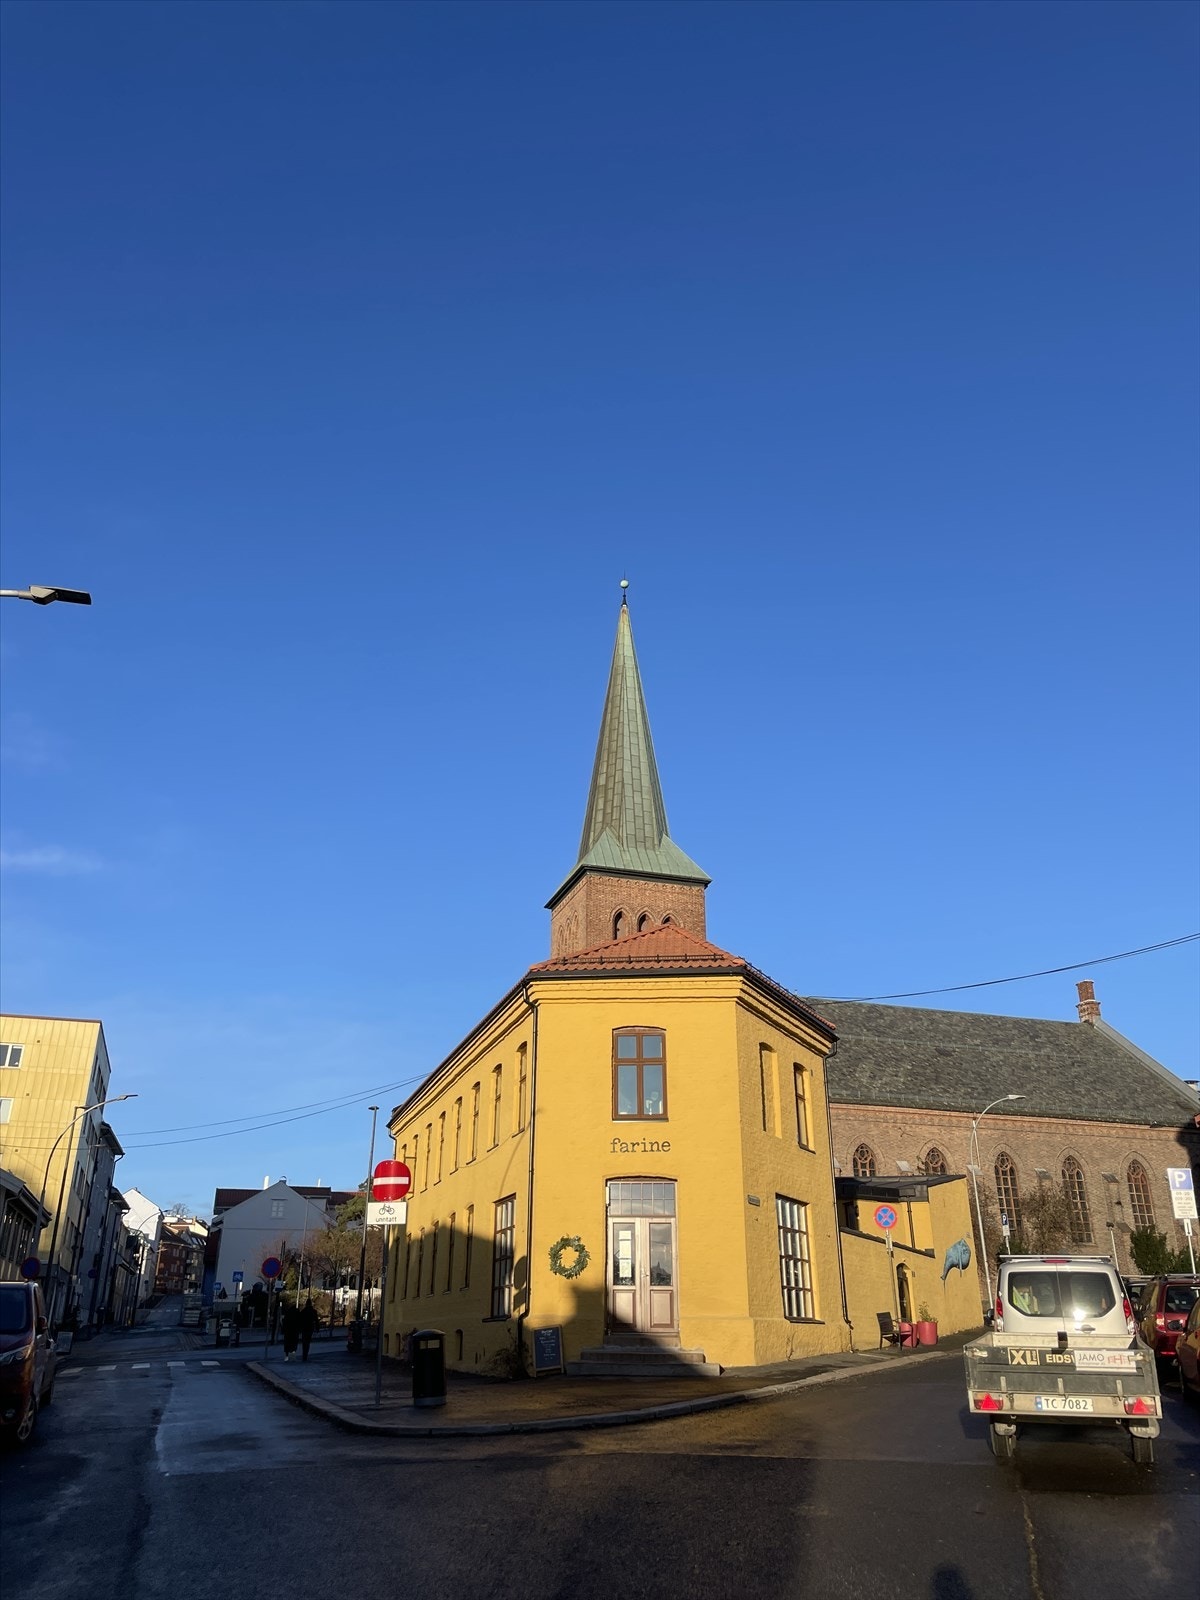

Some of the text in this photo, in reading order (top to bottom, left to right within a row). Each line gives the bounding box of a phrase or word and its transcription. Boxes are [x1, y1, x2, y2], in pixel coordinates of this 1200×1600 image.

[610, 1137, 671, 1153] farine
[1174, 1171, 1187, 1188] P
[1078, 1353, 1105, 1362] JAMO
[1044, 1399, 1088, 1409] TC 7082
